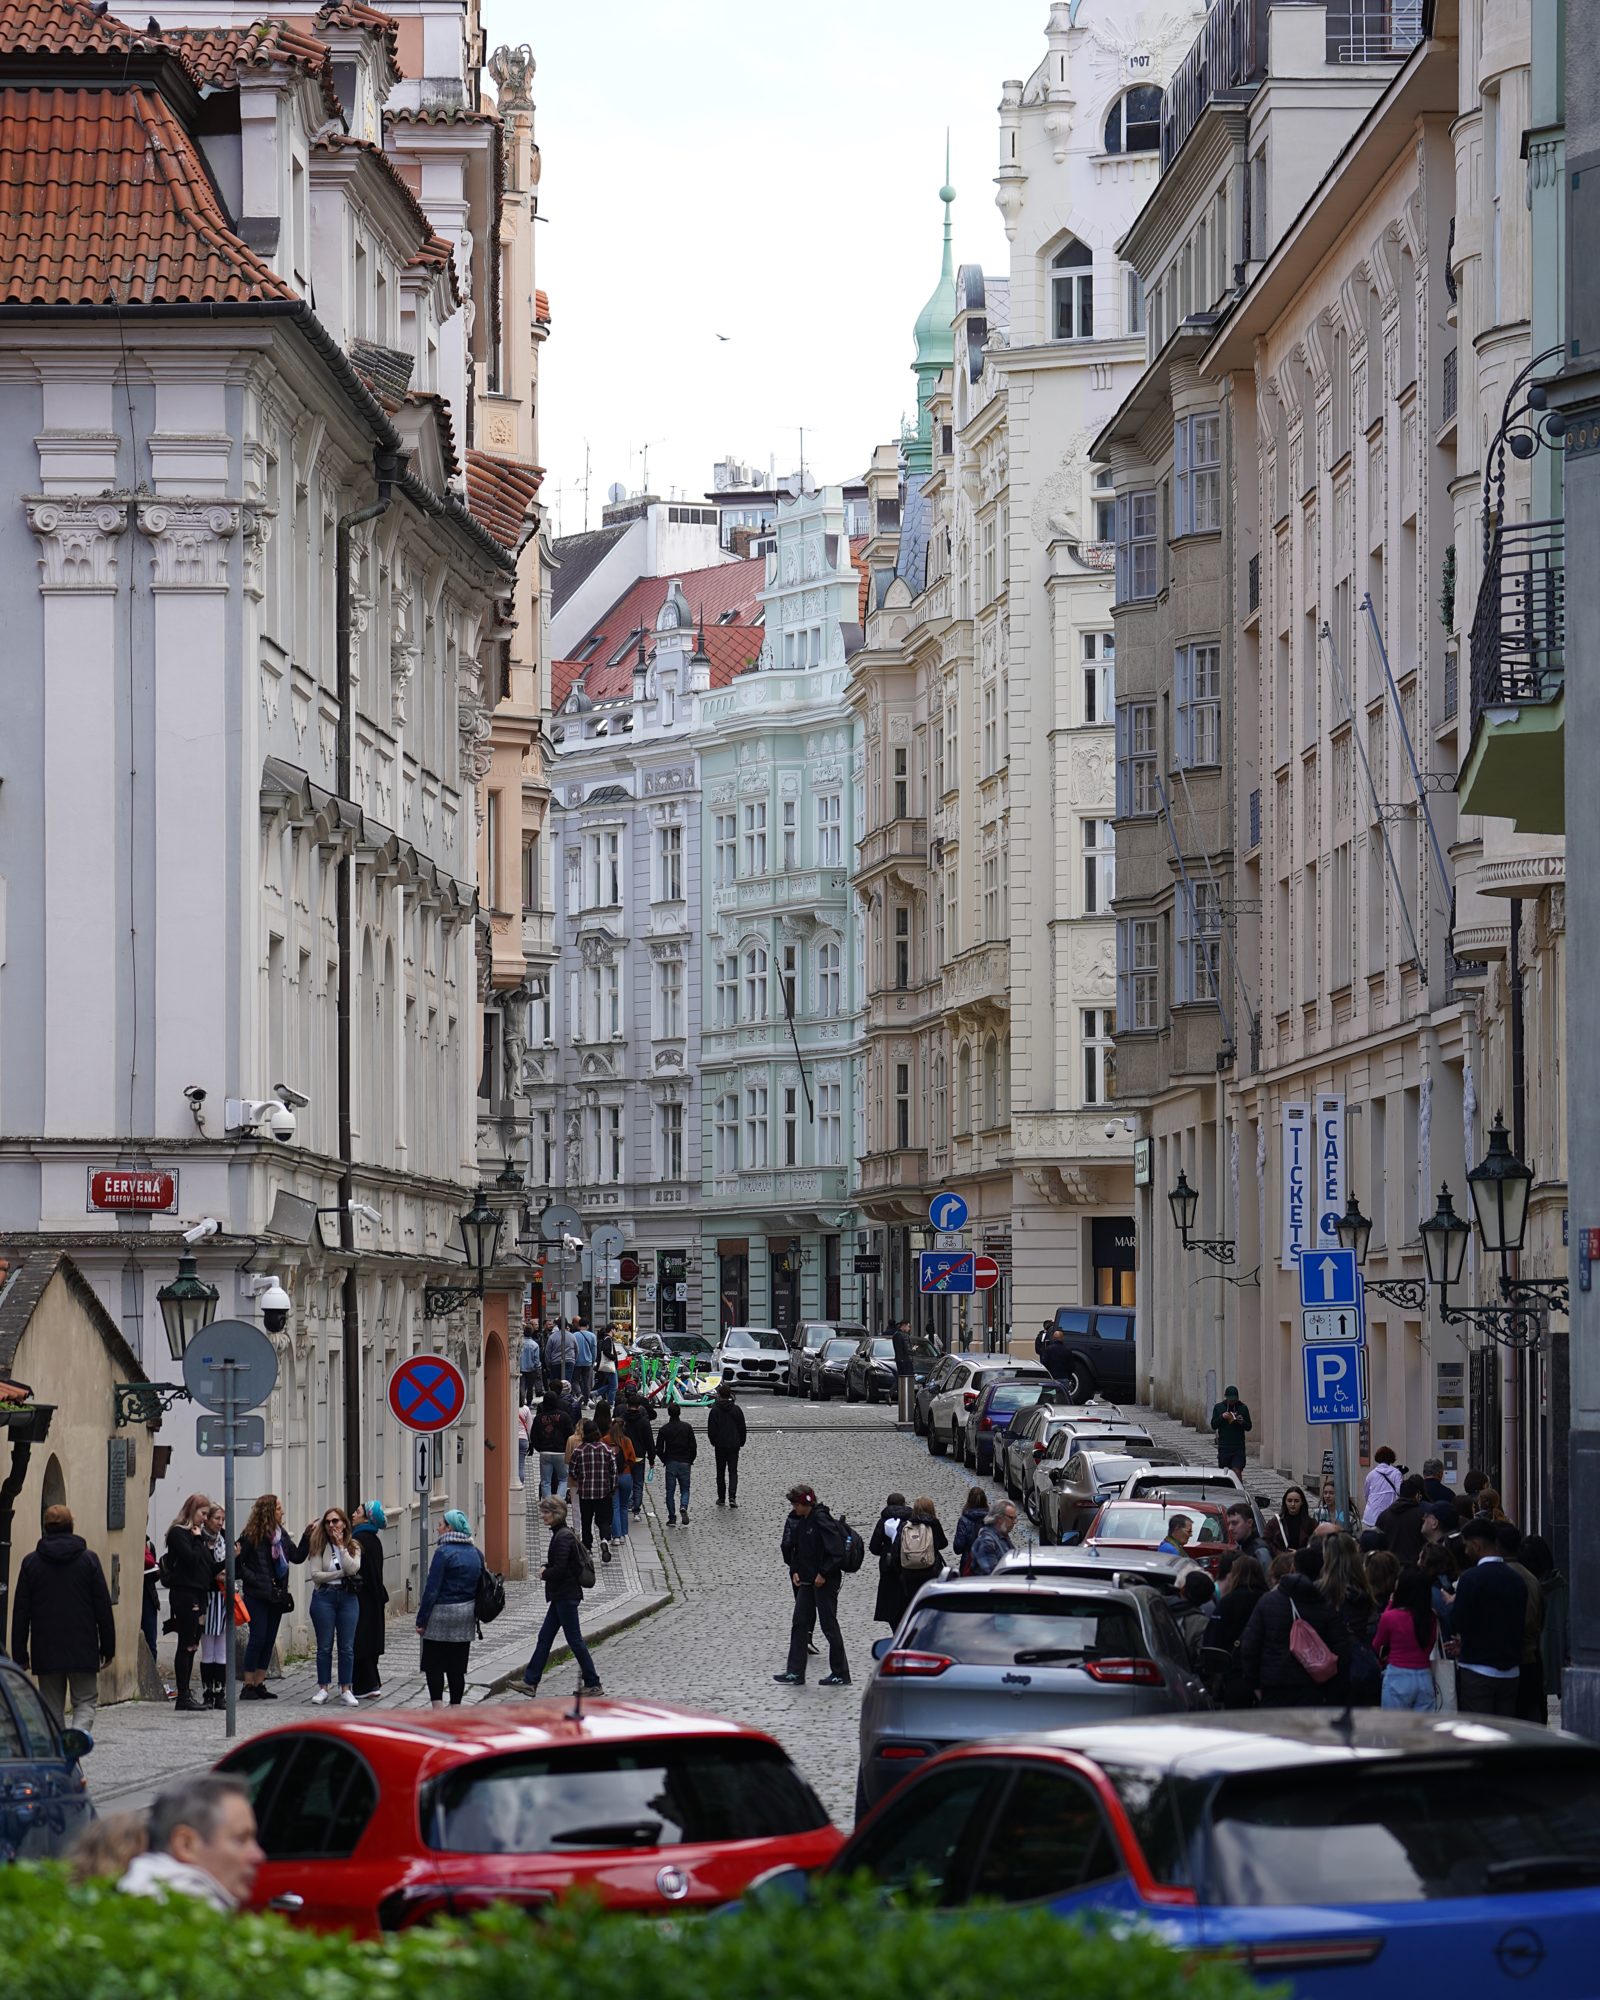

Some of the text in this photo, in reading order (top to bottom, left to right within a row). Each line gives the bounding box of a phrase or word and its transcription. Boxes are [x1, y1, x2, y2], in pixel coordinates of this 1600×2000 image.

[1130, 55, 1150, 68] 1907
[1324, 1119, 1338, 1200] CAFÉ
[105, 1177, 160, 1193] ČERVENÁ
[1290, 1128, 1303, 1262] TICKETS
[1316, 1354, 1347, 1399] P
[1312, 1403, 1356, 1414] MAX. 4 hod.
[1001, 1672, 1032, 1686] Jeep
